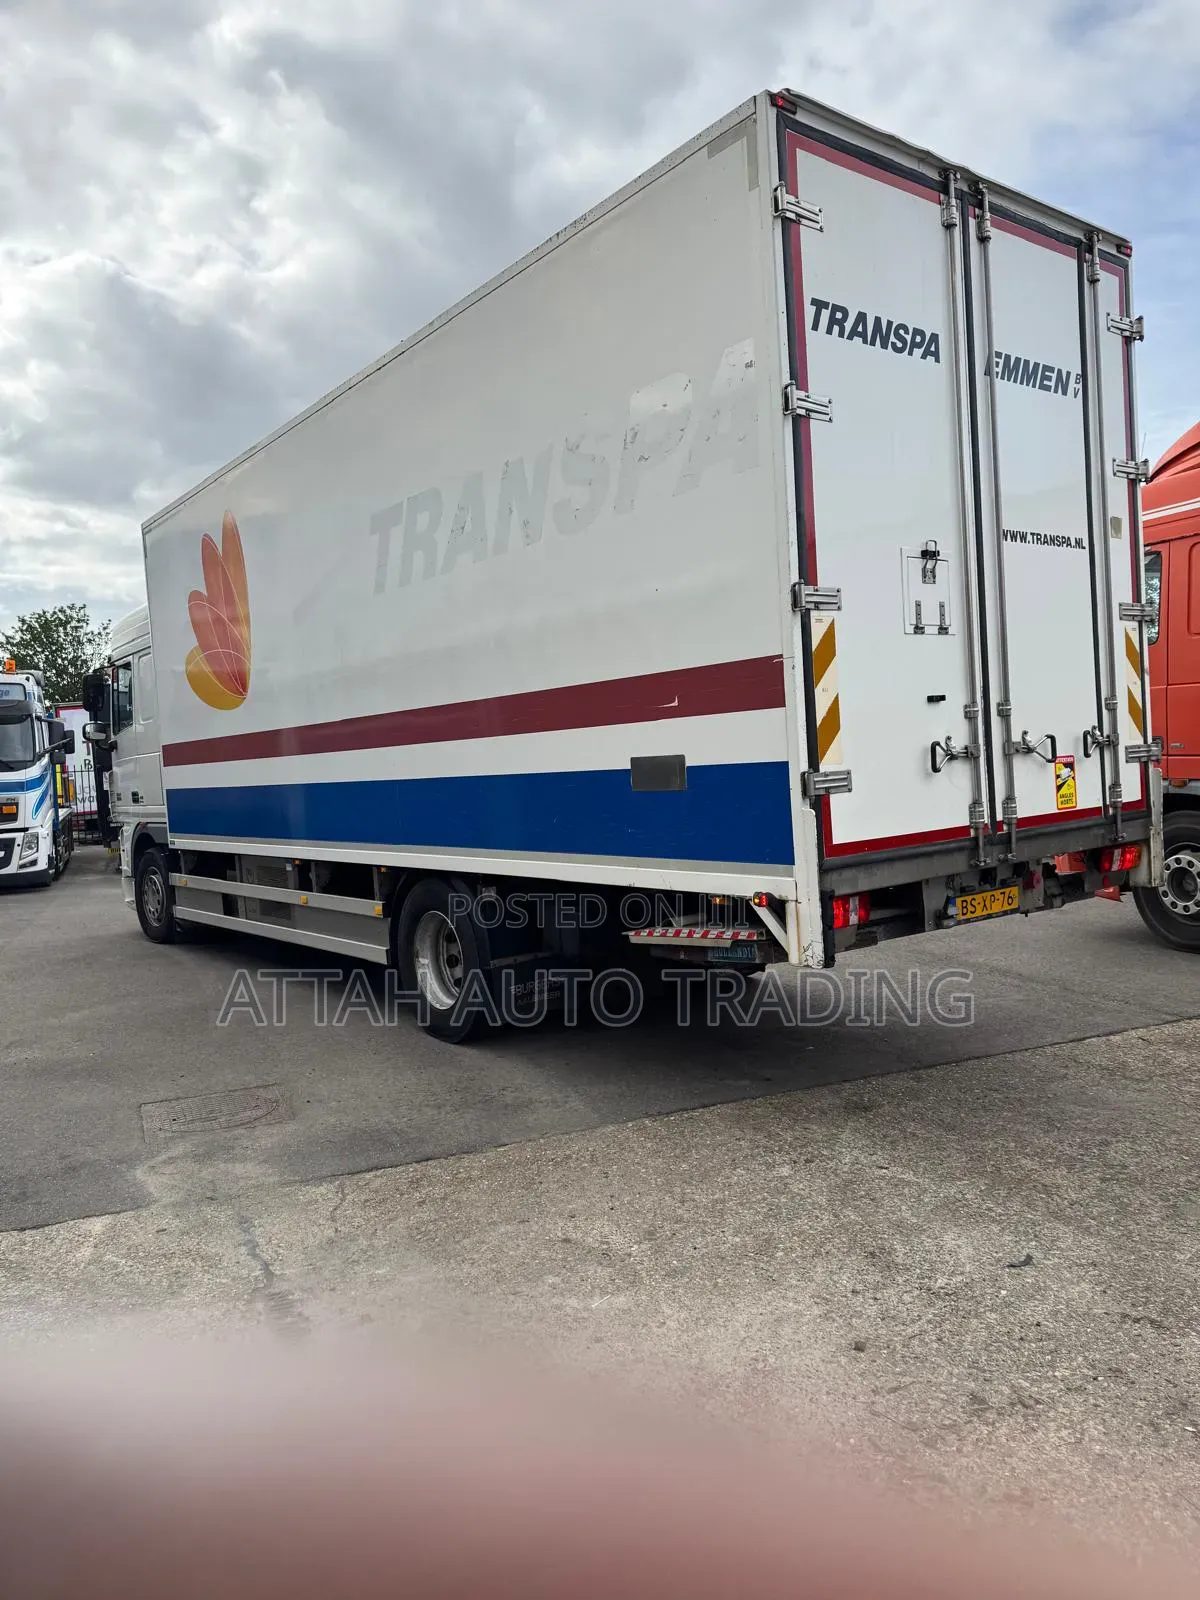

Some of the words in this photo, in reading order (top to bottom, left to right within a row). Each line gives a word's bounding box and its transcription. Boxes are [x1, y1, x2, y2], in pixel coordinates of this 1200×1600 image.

[810, 297, 941, 364] TRANSPA
[984, 350, 1072, 397] EMMEN
[370, 337, 760, 596] TRANSPA
[961, 889, 1015, 917] BS-XP-76
